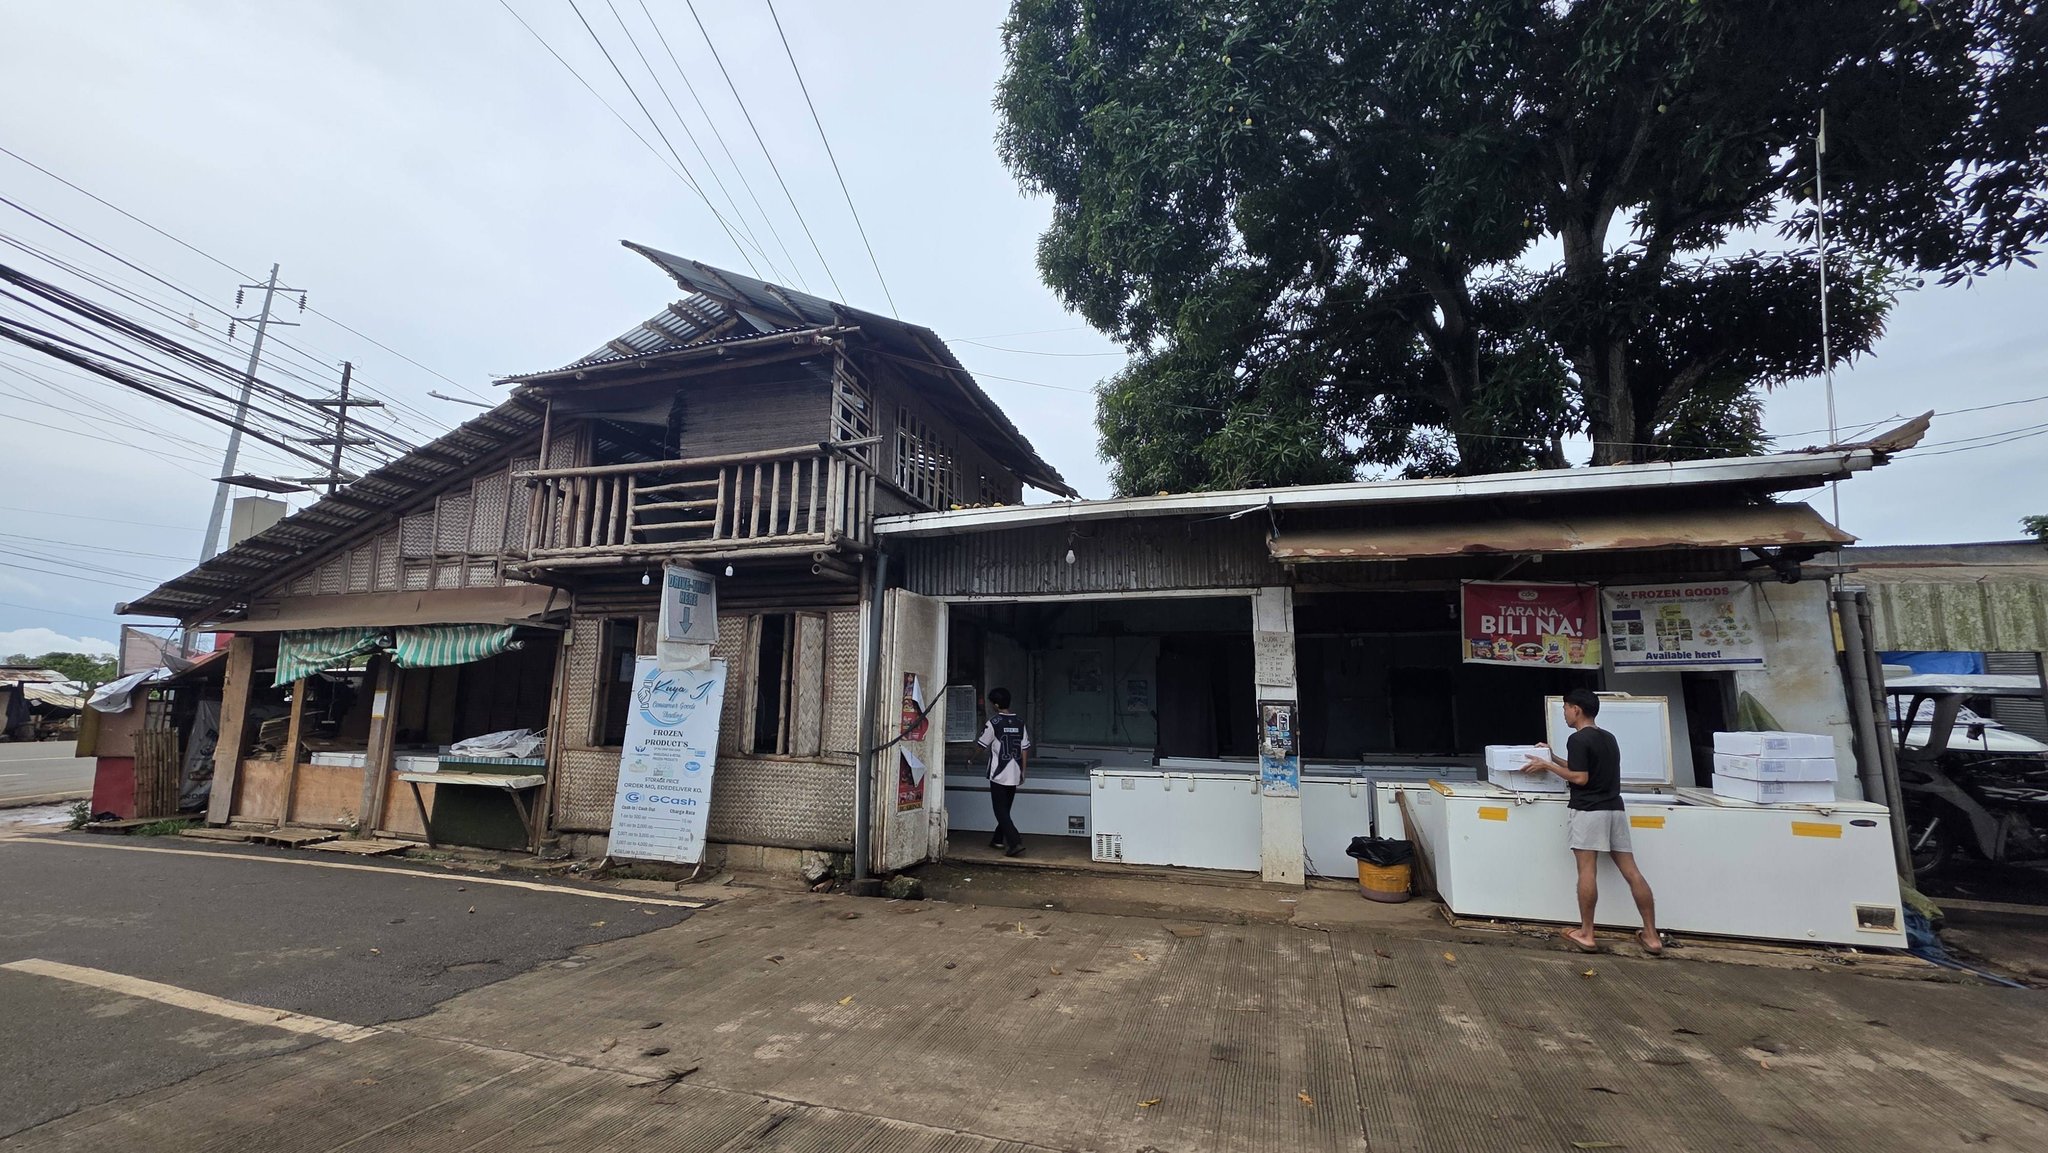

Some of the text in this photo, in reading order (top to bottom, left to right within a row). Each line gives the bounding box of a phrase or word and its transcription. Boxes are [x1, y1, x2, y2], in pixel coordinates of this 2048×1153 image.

[668, 574, 711, 595] DRIVE-THRU
[679, 591, 698, 606] HERE
[1631, 587, 1729, 600] FROZEN GOODS
[1499, 606, 1563, 620] TARA NA,
[1481, 615, 1583, 637] BILI NA!
[1646, 650, 1721, 660] Available here!
[652, 679, 715, 701] Kuya J
[652, 701, 696, 710] Consumer Goods
[653, 729, 684, 737] FROZEN
[644, 739, 689, 748] PRODUCT'S
[1000, 734, 1021, 760] 15
[657, 785, 692, 793] EDEDELIVER
[648, 795, 697, 806] GCash
